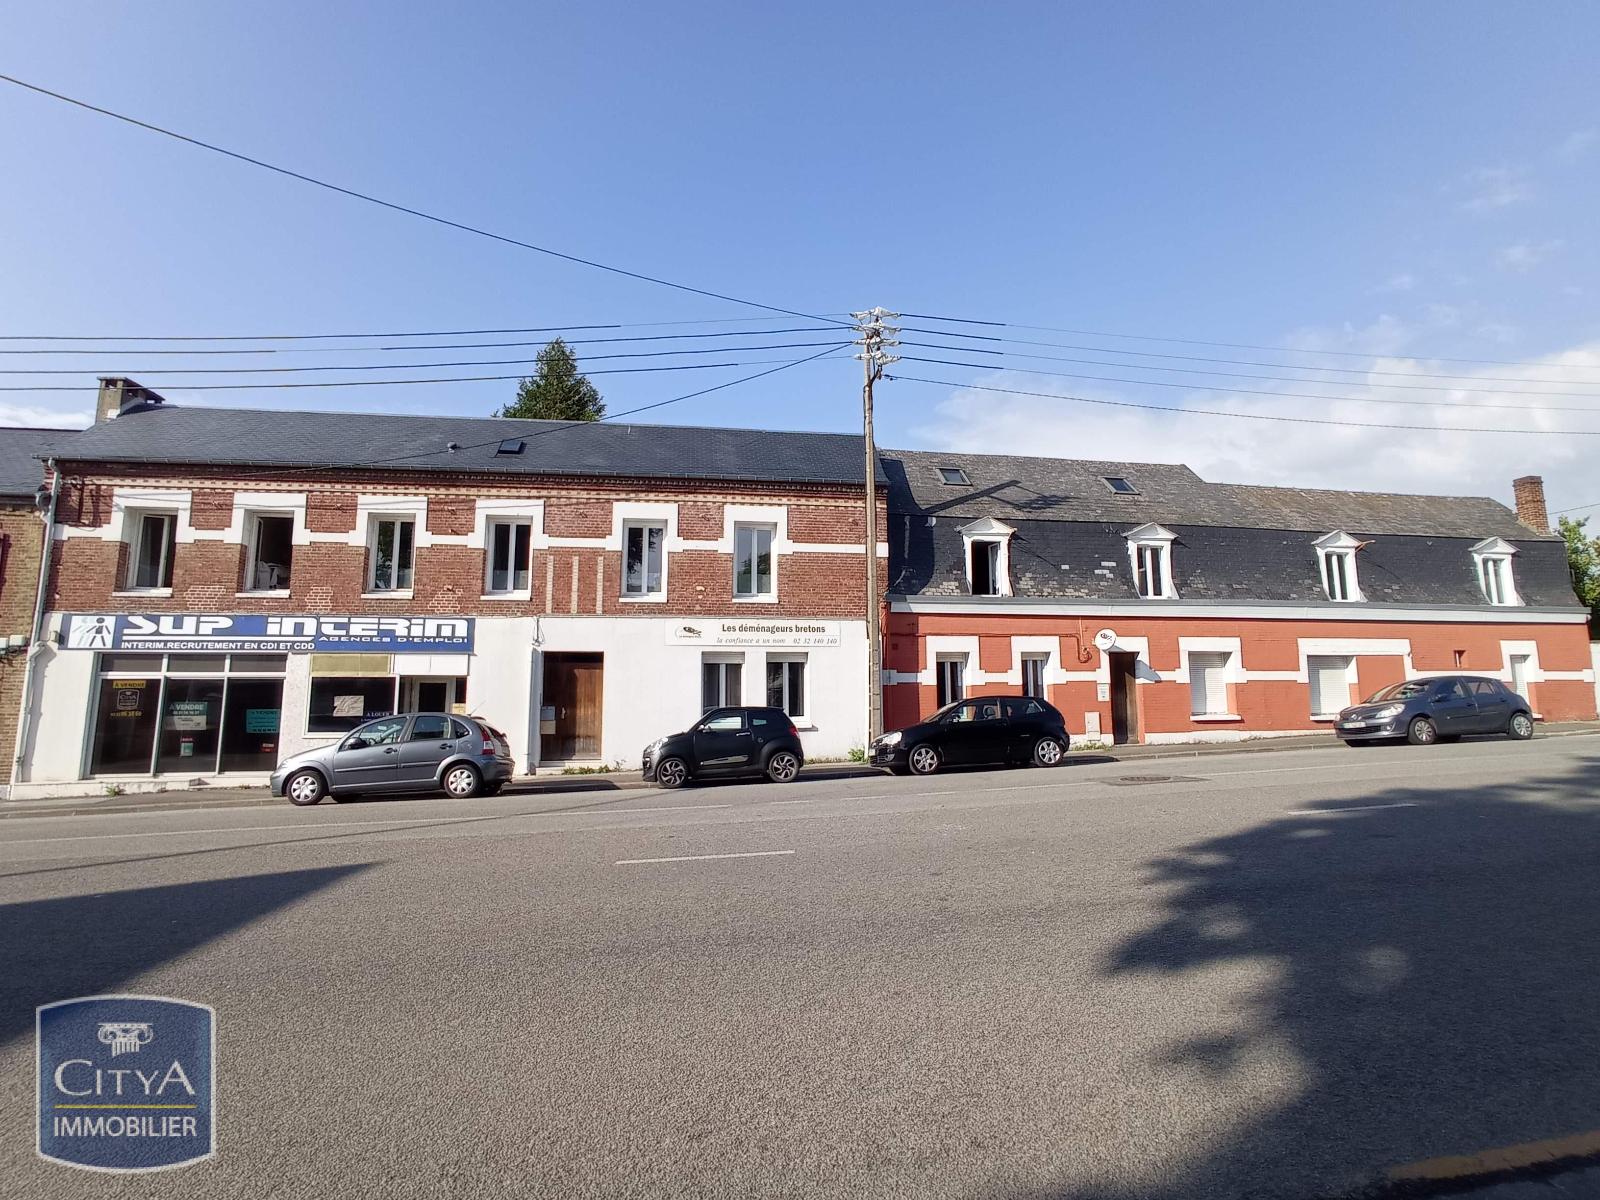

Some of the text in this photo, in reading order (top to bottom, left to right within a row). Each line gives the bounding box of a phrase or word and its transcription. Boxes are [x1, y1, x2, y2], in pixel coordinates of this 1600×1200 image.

[122, 615, 234, 635] SUP
[722, 623, 826, 635] Les déménageurs bretons
[725, 637, 754, 645] confiance
[244, 642, 259, 650] EN
[260, 642, 278, 650] CDI
[279, 642, 292, 650] ET
[294, 642, 315, 650] CDD
[176, 703, 205, 711] VENDRE
